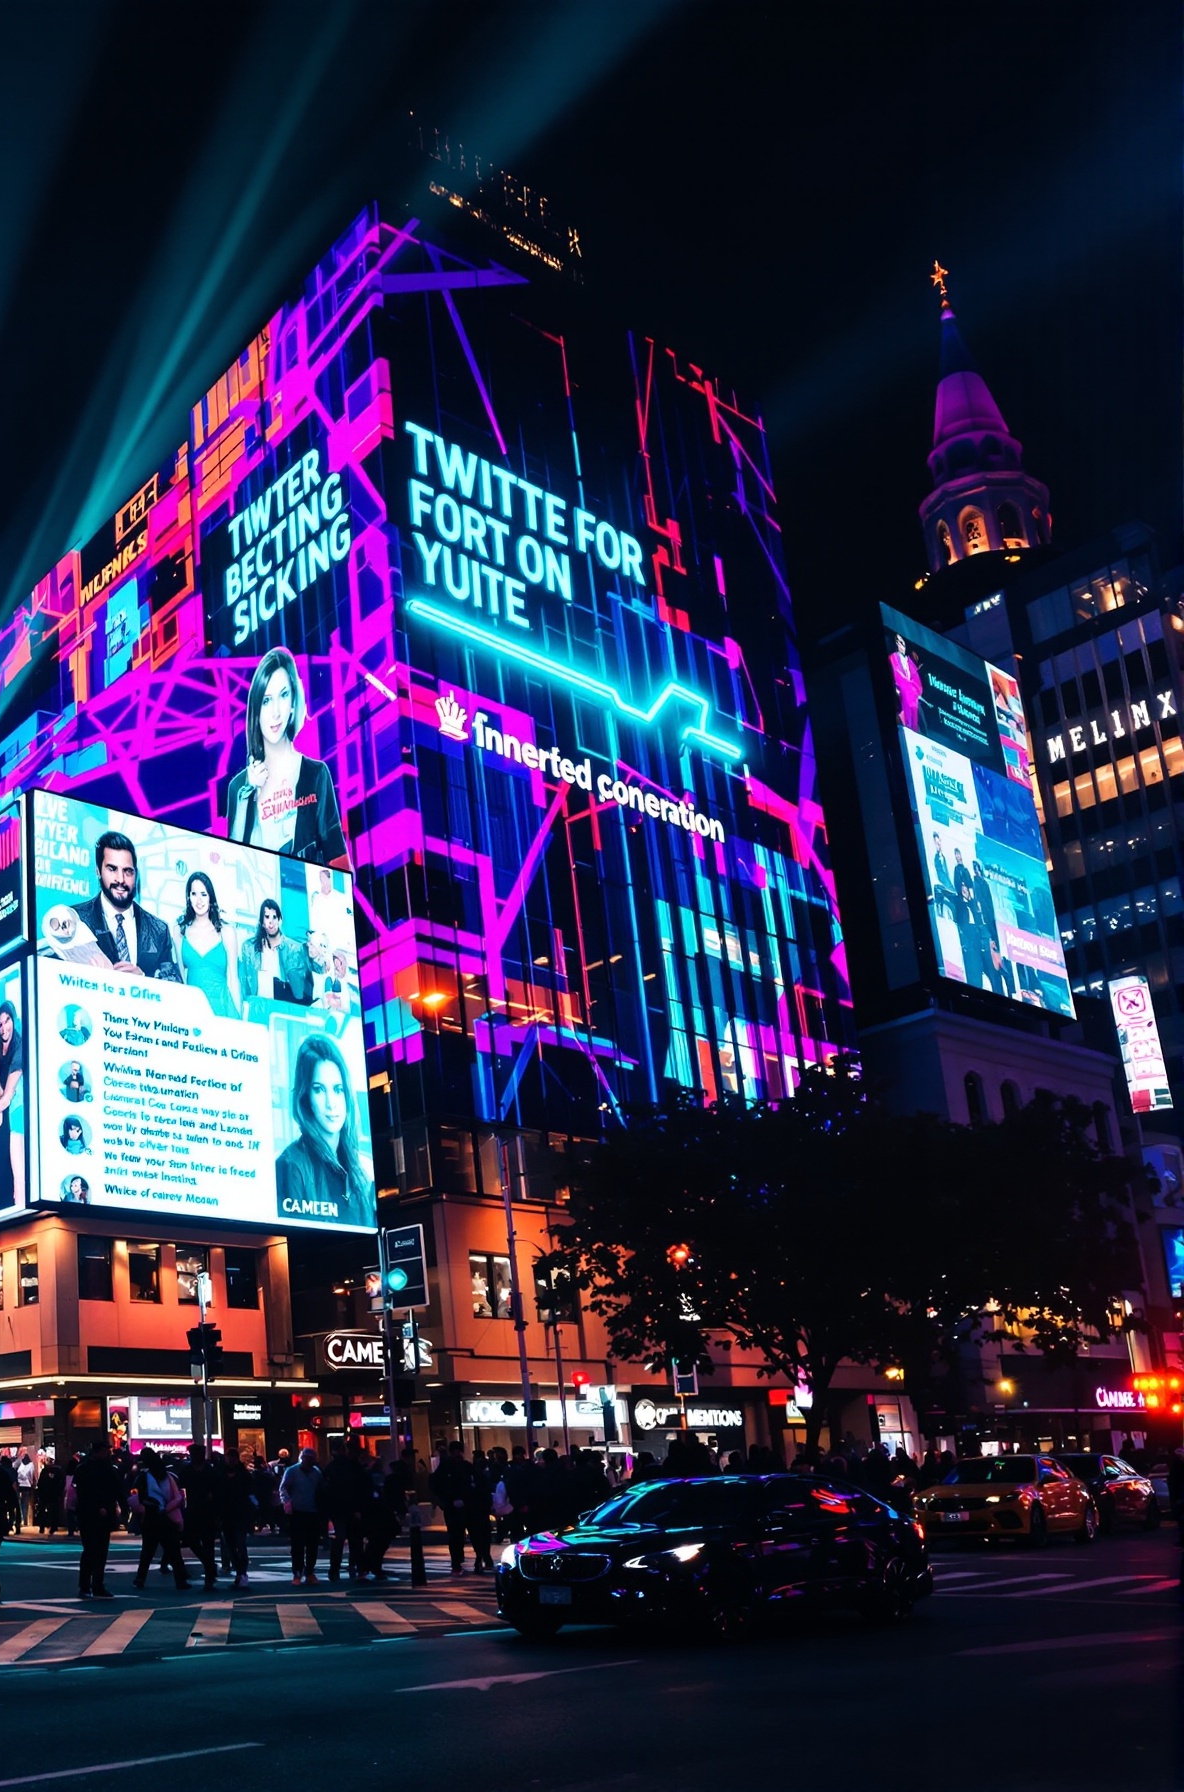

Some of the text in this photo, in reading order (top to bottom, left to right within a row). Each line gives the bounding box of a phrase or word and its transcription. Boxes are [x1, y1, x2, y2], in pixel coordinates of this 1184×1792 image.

[225, 472, 342, 606] BECTING
[405, 421, 646, 586] TWITTE FOR
[409, 479, 574, 601] FORT ON
[234, 513, 351, 646] SICKING
[412, 532, 530, 628] YUITE
[327, 1339, 393, 1364] CAME
